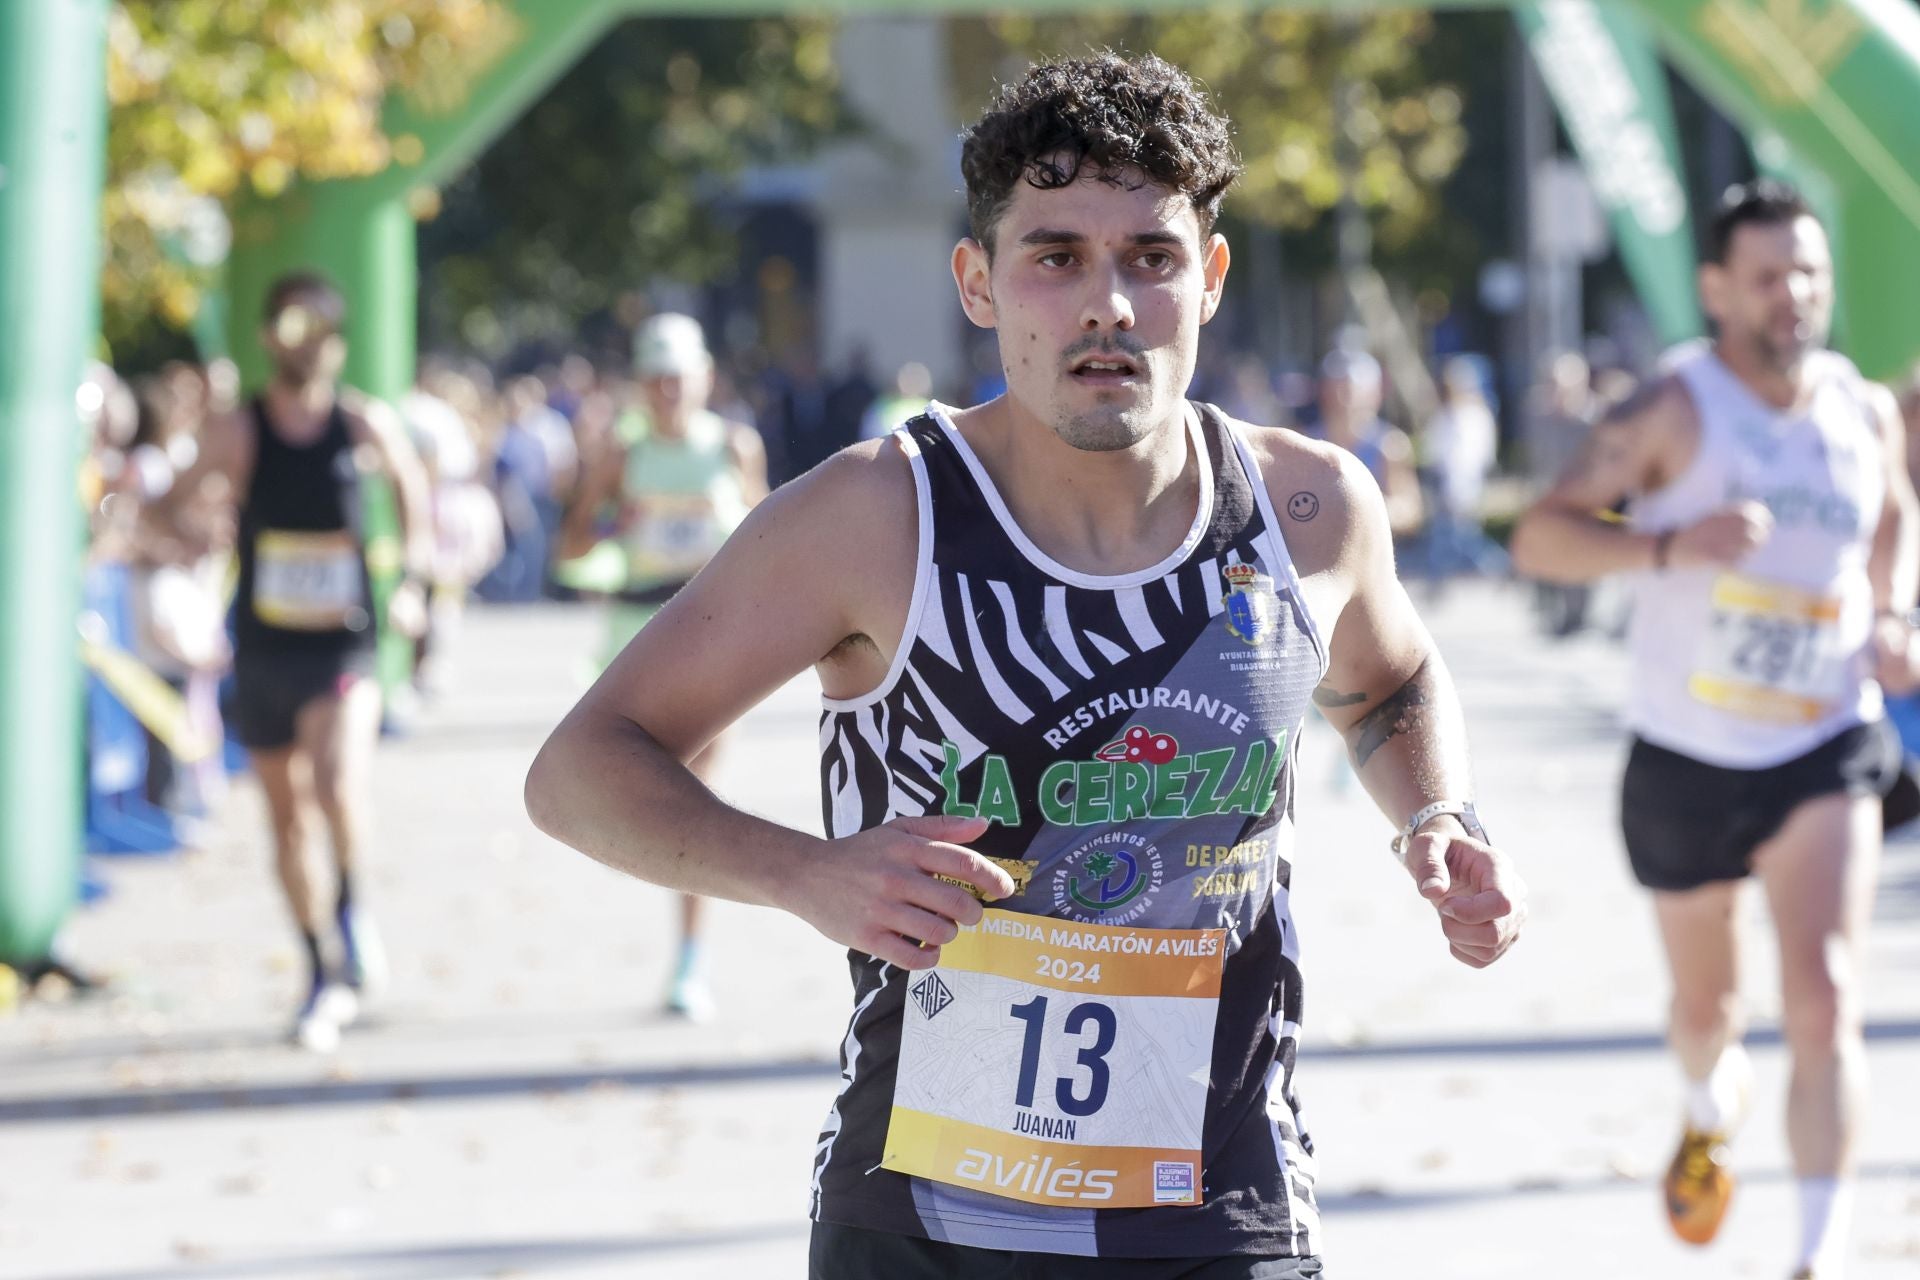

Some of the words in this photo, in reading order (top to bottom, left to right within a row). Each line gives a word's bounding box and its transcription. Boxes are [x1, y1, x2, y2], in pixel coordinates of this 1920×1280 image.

[1043, 687, 1250, 750] RESTAURANTE
[941, 739, 1021, 826] LA
[1038, 729, 1288, 826] CEREZAL
[1065, 832, 1146, 864] PAVIMENTOS
[1145, 844, 1163, 893] ETUSTA
[982, 917, 1045, 943] MEDIA
[1049, 928, 1152, 955] MARATÓN
[1154, 933, 1217, 957] AVILÉS
[1035, 954, 1101, 984] 2024
[1010, 994, 1117, 1117] 13
[1012, 1111, 1077, 1141] JUANAN
[954, 1148, 1119, 1200] avilés
